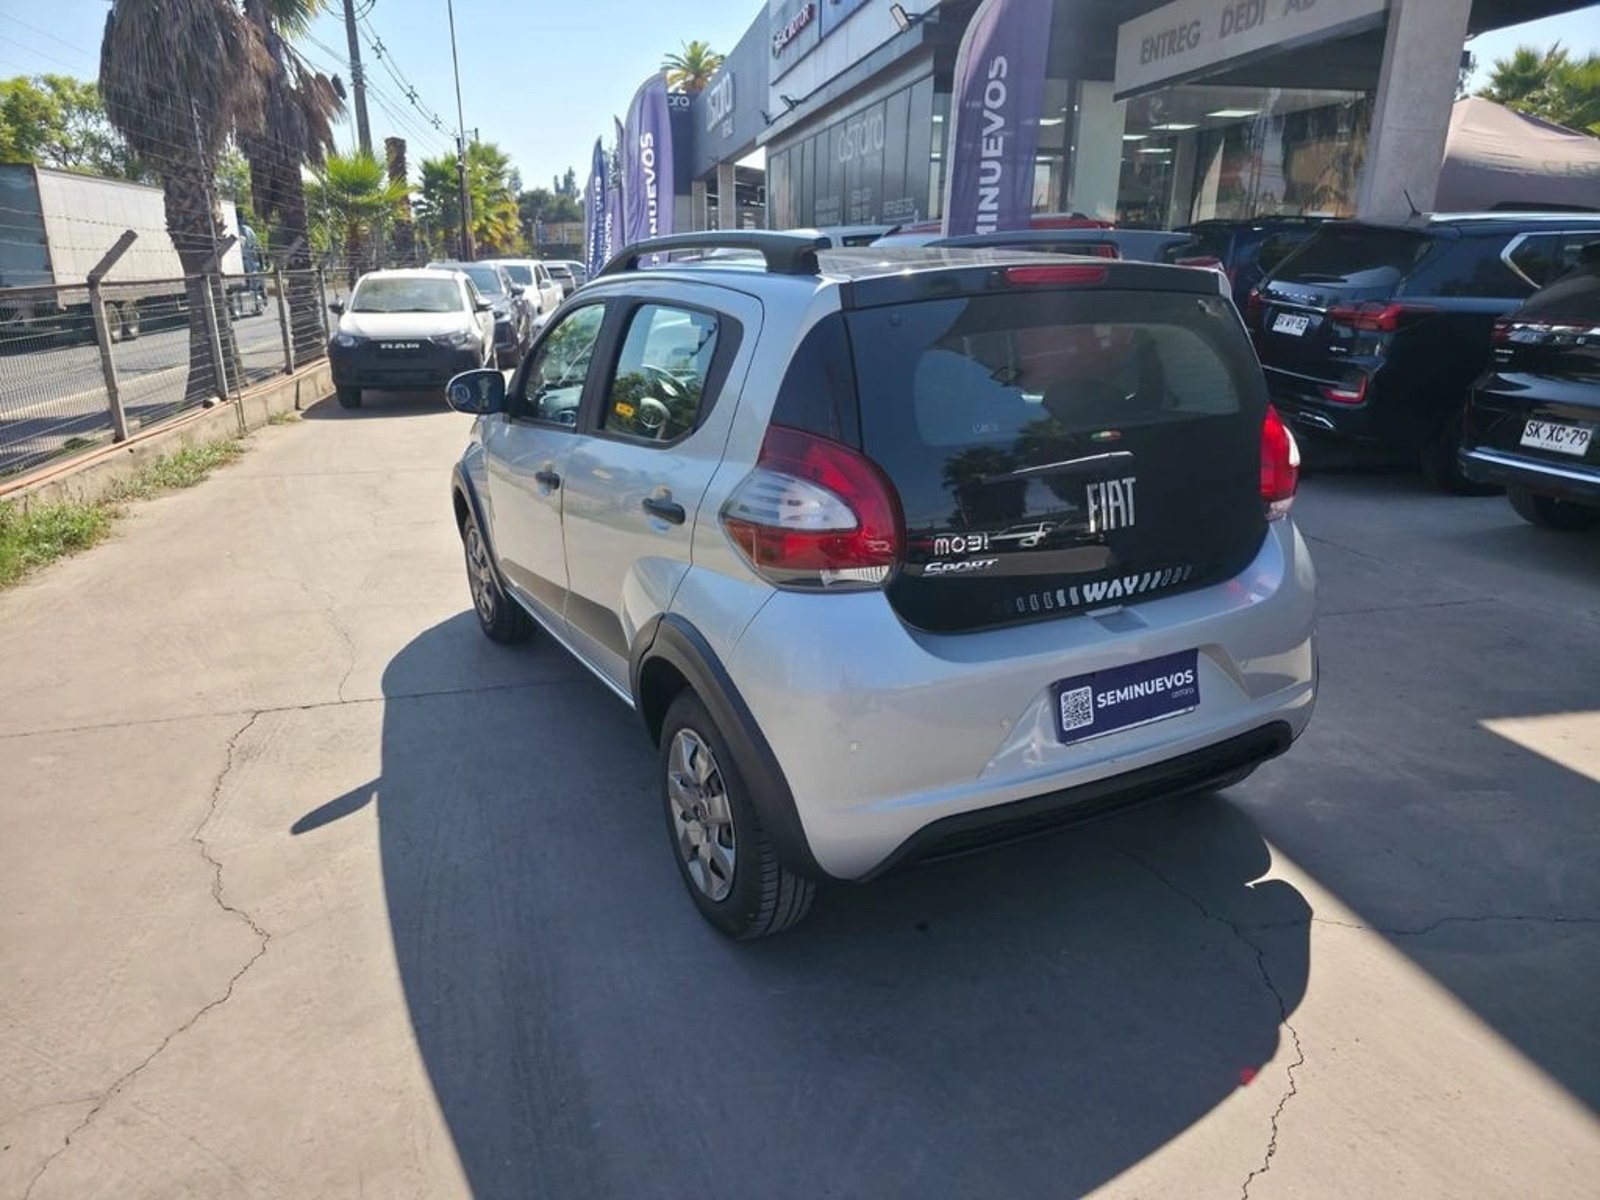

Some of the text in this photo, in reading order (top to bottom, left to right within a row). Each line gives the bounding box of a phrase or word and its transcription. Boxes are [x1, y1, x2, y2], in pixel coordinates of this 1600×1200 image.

[1087, 477, 1136, 533] FIAT
[1083, 575, 1139, 603] WAY
[1097, 669, 1194, 708] SEMINUEVOS
